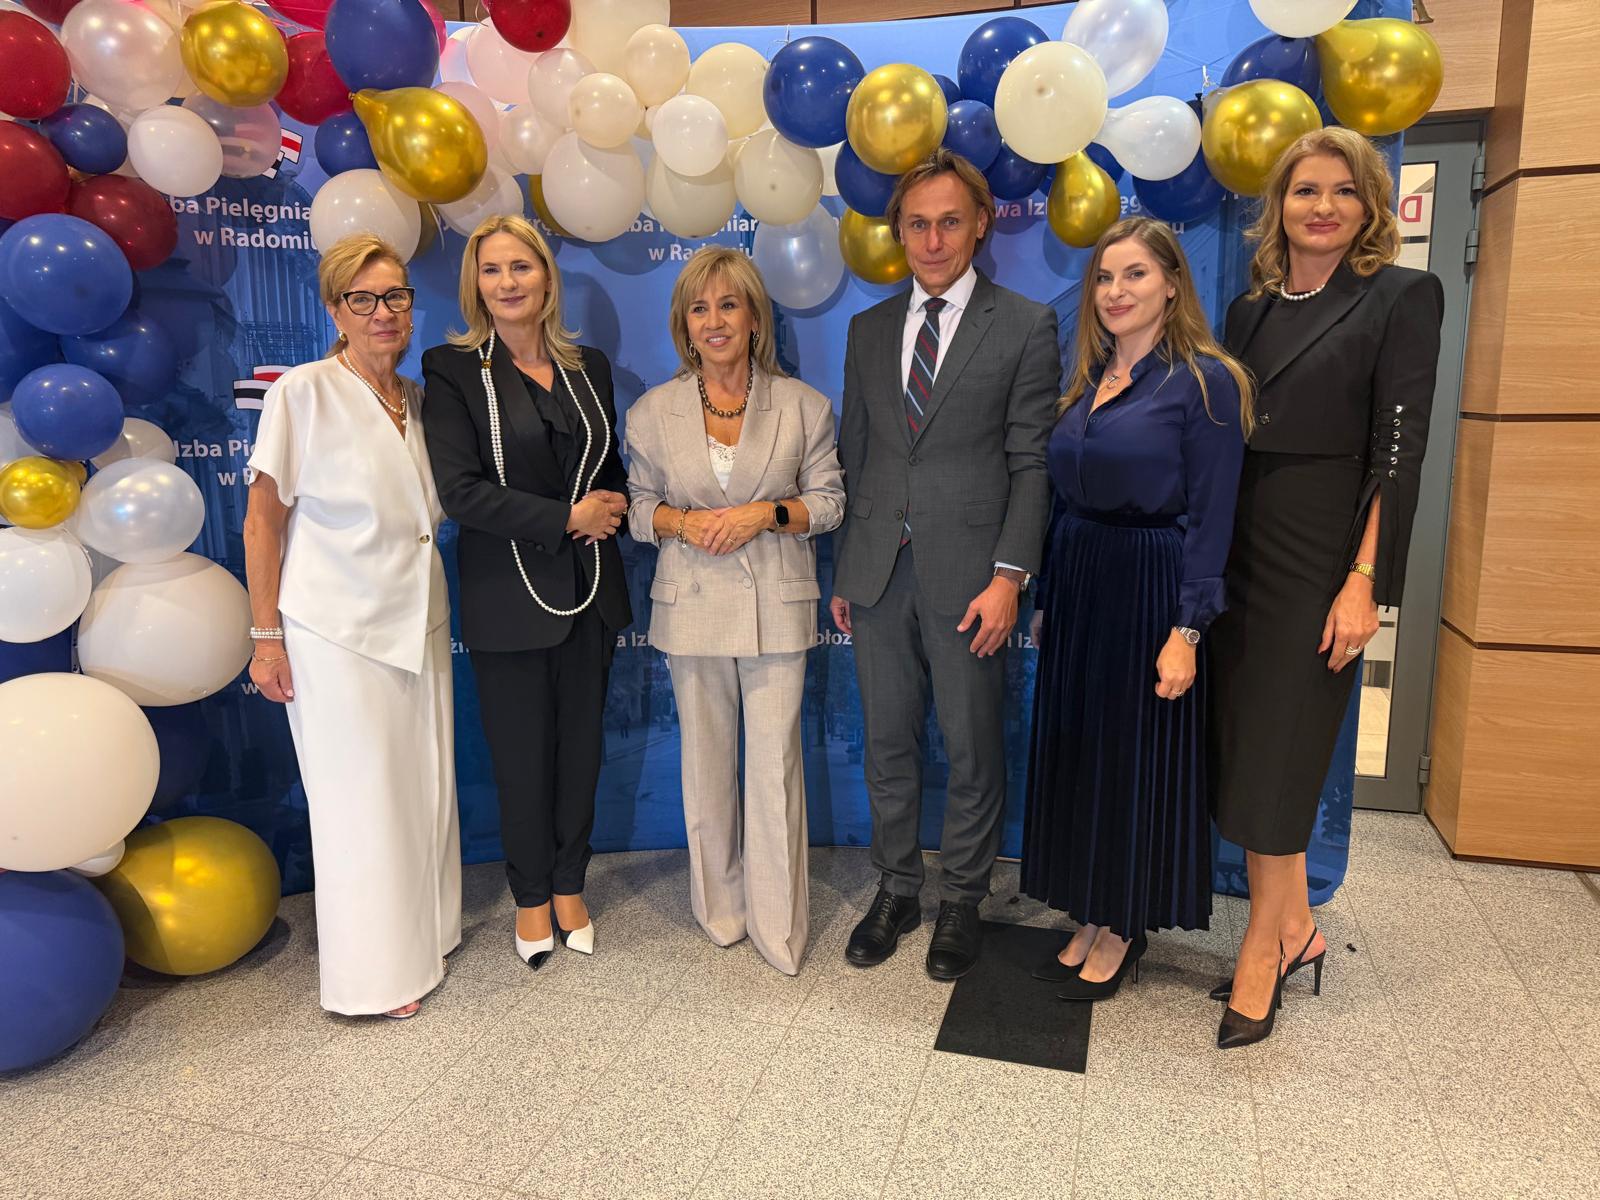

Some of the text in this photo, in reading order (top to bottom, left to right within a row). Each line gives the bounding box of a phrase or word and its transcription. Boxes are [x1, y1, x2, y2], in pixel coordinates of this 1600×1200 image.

[169, 196, 199, 214] ba
[194, 230, 214, 246] w
[648, 247, 665, 261] w
[174, 439, 222, 457] Izba
[217, 471, 237, 486] w
